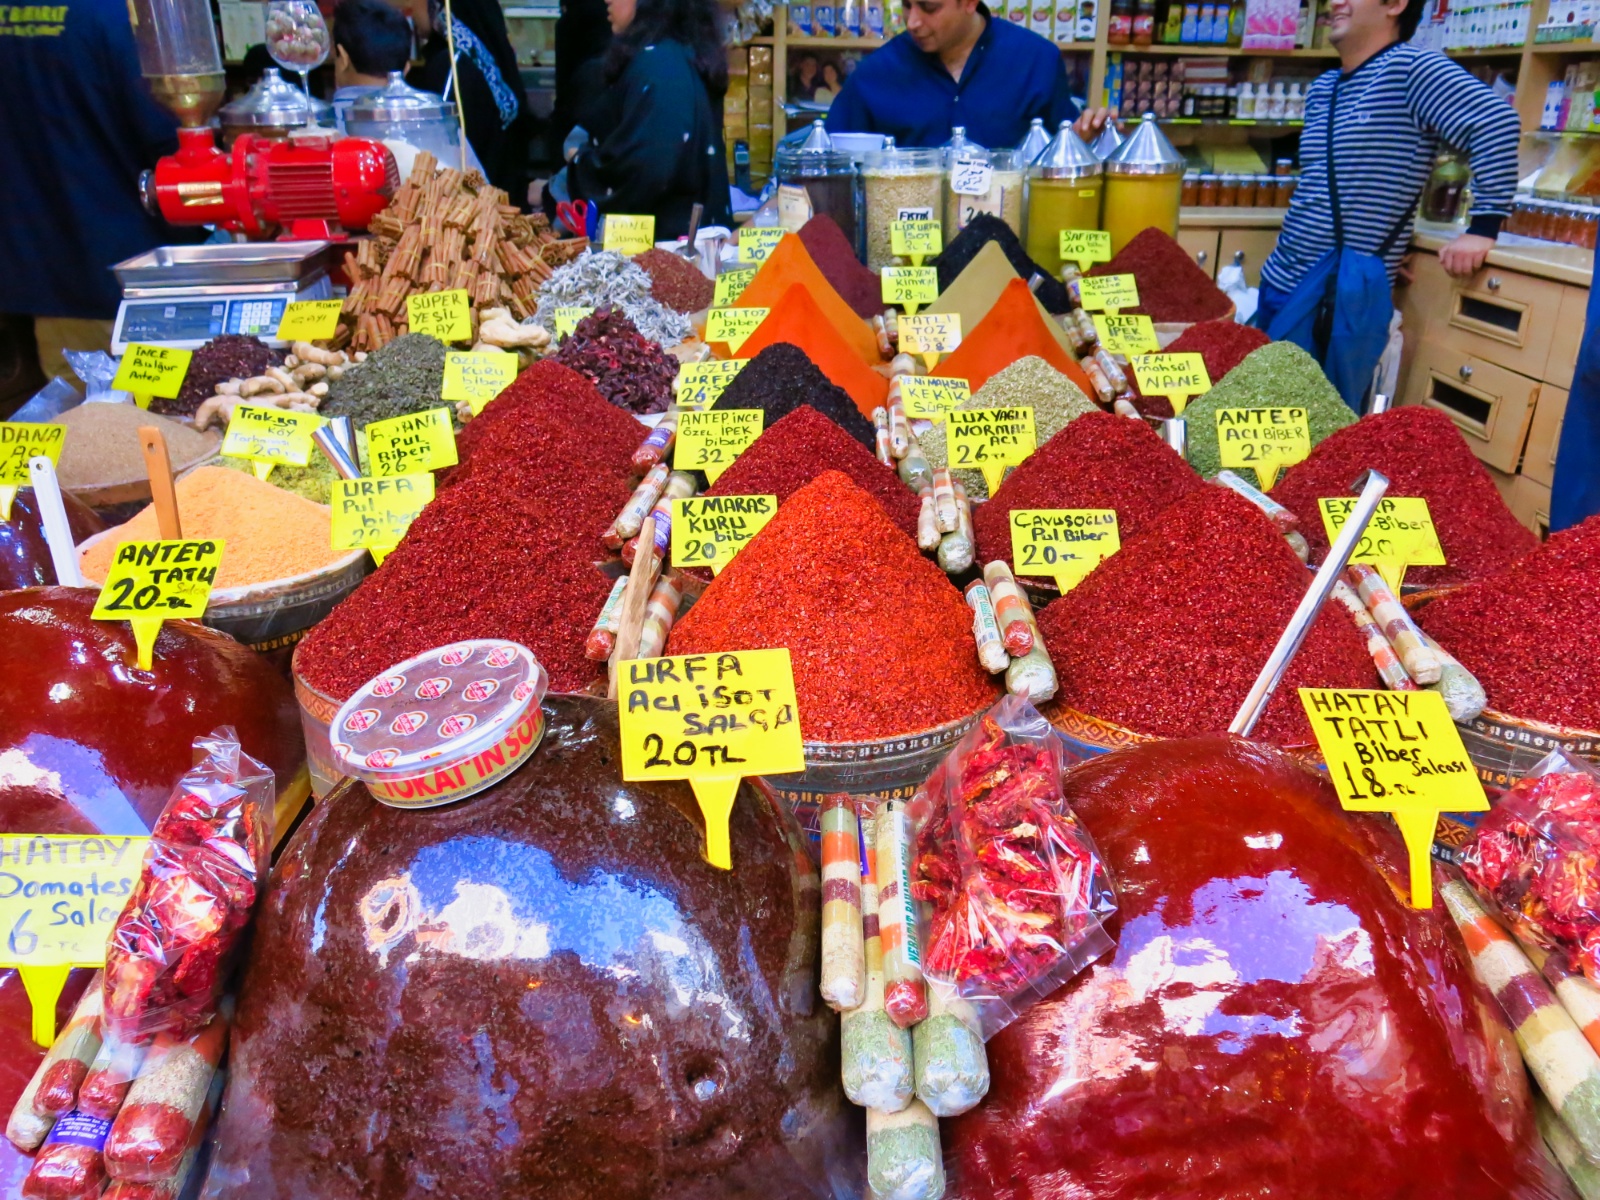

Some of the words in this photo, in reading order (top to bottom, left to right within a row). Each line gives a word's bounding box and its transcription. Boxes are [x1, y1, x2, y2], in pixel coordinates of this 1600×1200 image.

[611, 231, 652, 247] Sumak
[1063, 244, 1085, 253] 40
[412, 291, 462, 310] SÜPER
[895, 288, 914, 301] 28
[901, 314, 952, 325] TATLI
[717, 328, 737, 339] 28
[912, 325, 947, 335] TOZ
[129, 370, 161, 383] Antep
[1145, 374, 1201, 389] NANE
[681, 386, 707, 404] 26
[239, 406, 298, 427] Trakya
[680, 412, 729, 426] ANTEP
[1219, 408, 1303, 426] ANTEP
[955, 423, 1032, 438] NORMAL
[1226, 429, 1259, 442] ACI
[252, 444, 281, 457] 20
[696, 447, 724, 465] 32
[956, 443, 989, 464] 26
[380, 458, 407, 477] 26
[343, 478, 414, 497] URFA
[342, 497, 375, 514] Pul
[688, 515, 747, 534] KURU
[117, 541, 217, 567] ANTEP
[681, 539, 717, 563] 20
[1021, 544, 1058, 566] 20
[630, 654, 743, 685] URFA
[1309, 692, 1410, 717] HATAY
[1323, 716, 1430, 743] TATLI
[1353, 740, 1422, 766] Biber
[0, 836, 132, 867] HATAY
[7, 909, 38, 955] 6
